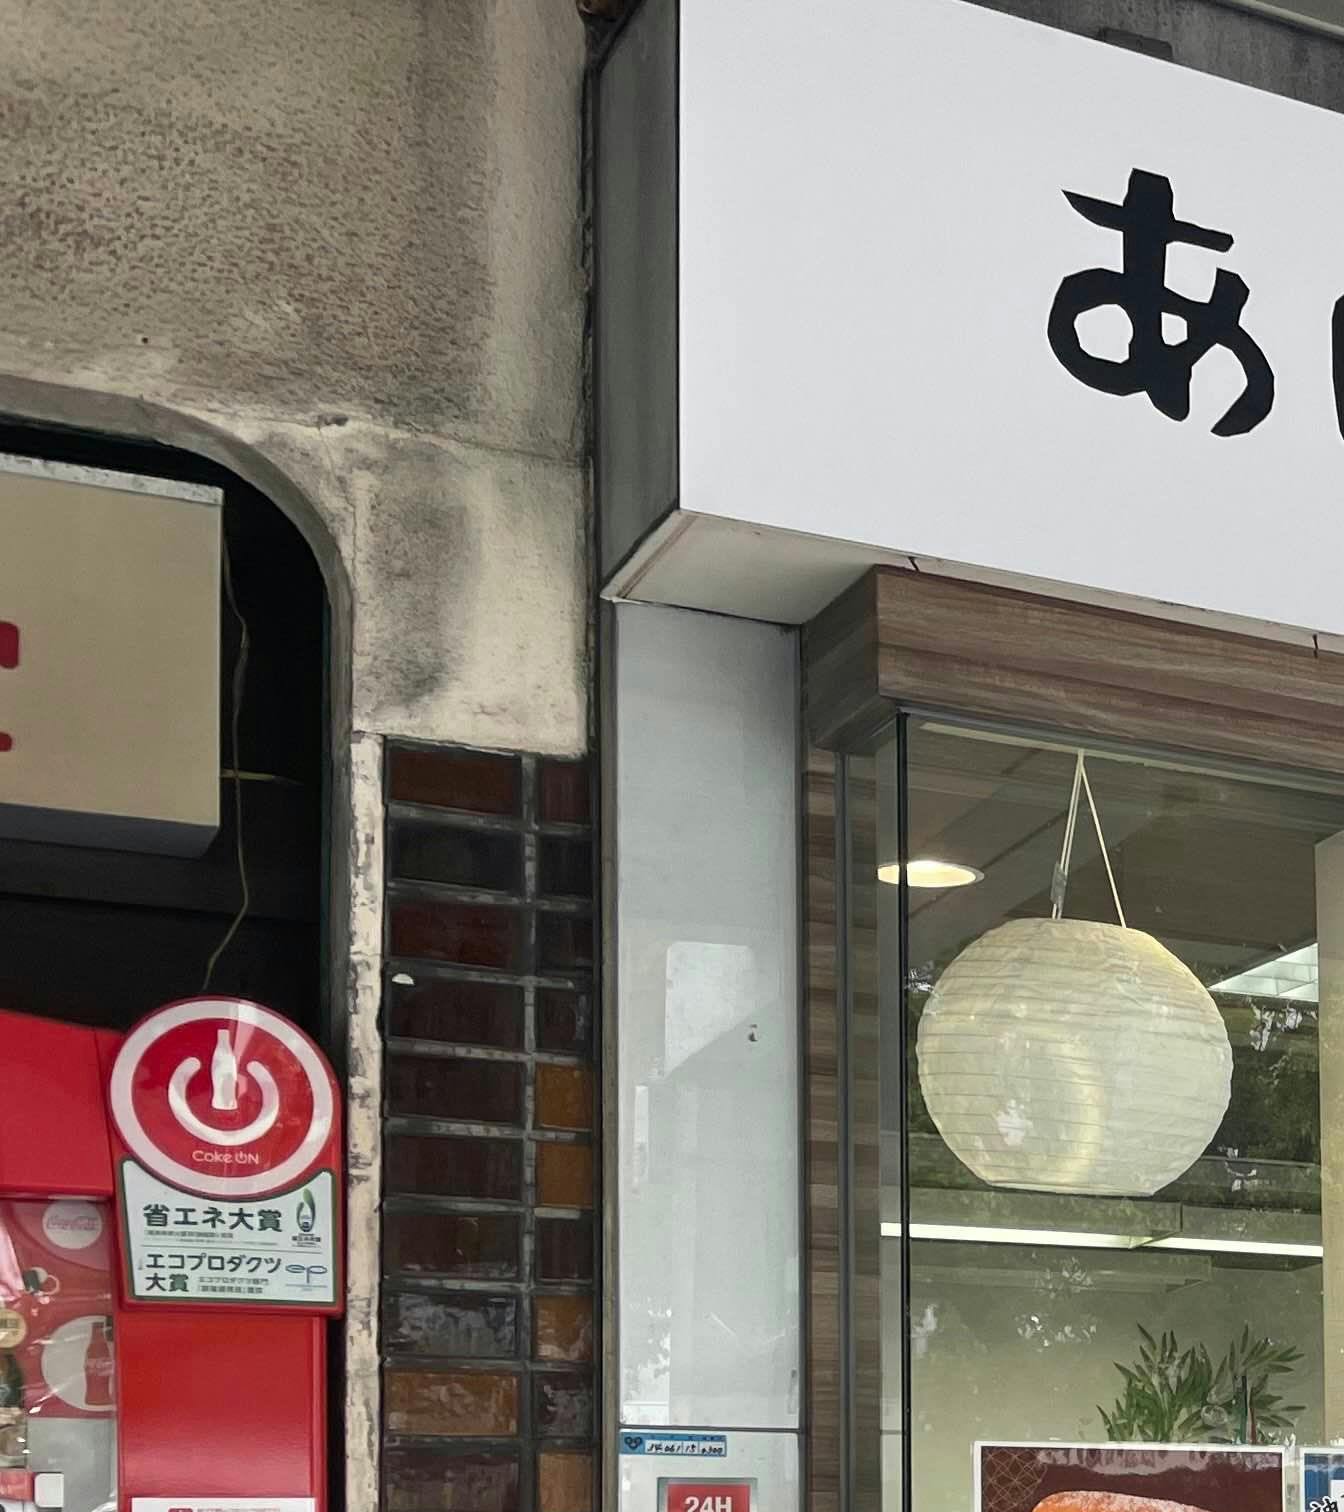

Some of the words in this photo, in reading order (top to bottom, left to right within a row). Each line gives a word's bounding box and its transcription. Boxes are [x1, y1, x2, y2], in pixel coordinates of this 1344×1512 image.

[192, 1150, 232, 1164] Coke
[143, 1203, 283, 1233] 省エネ大賞
[145, 1252, 282, 1274] エコプロダクツ
[145, 1272, 190, 1293] 大賞
